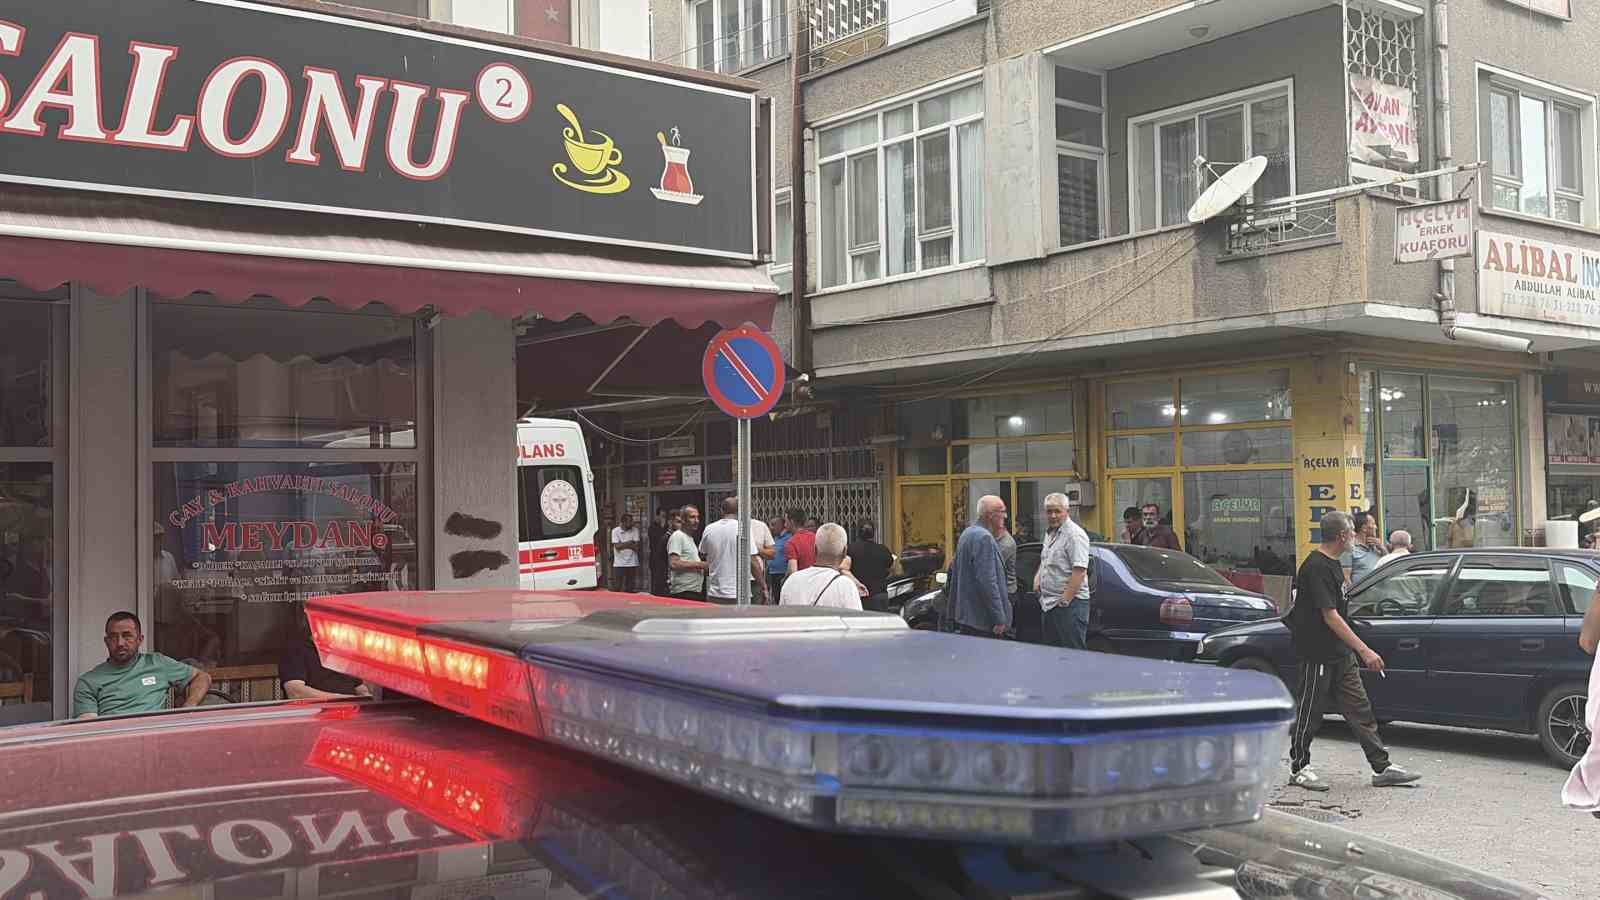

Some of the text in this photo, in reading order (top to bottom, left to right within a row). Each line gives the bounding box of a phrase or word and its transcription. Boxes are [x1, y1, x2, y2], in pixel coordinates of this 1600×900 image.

[1420, 223, 1454, 236] ERKEK
[1483, 238, 1578, 284] ALİBAL
[1514, 279, 1561, 297] ABDULLAH
[1304, 457, 1339, 470] AÇELYA
[201, 520, 373, 552] MEYDAN
